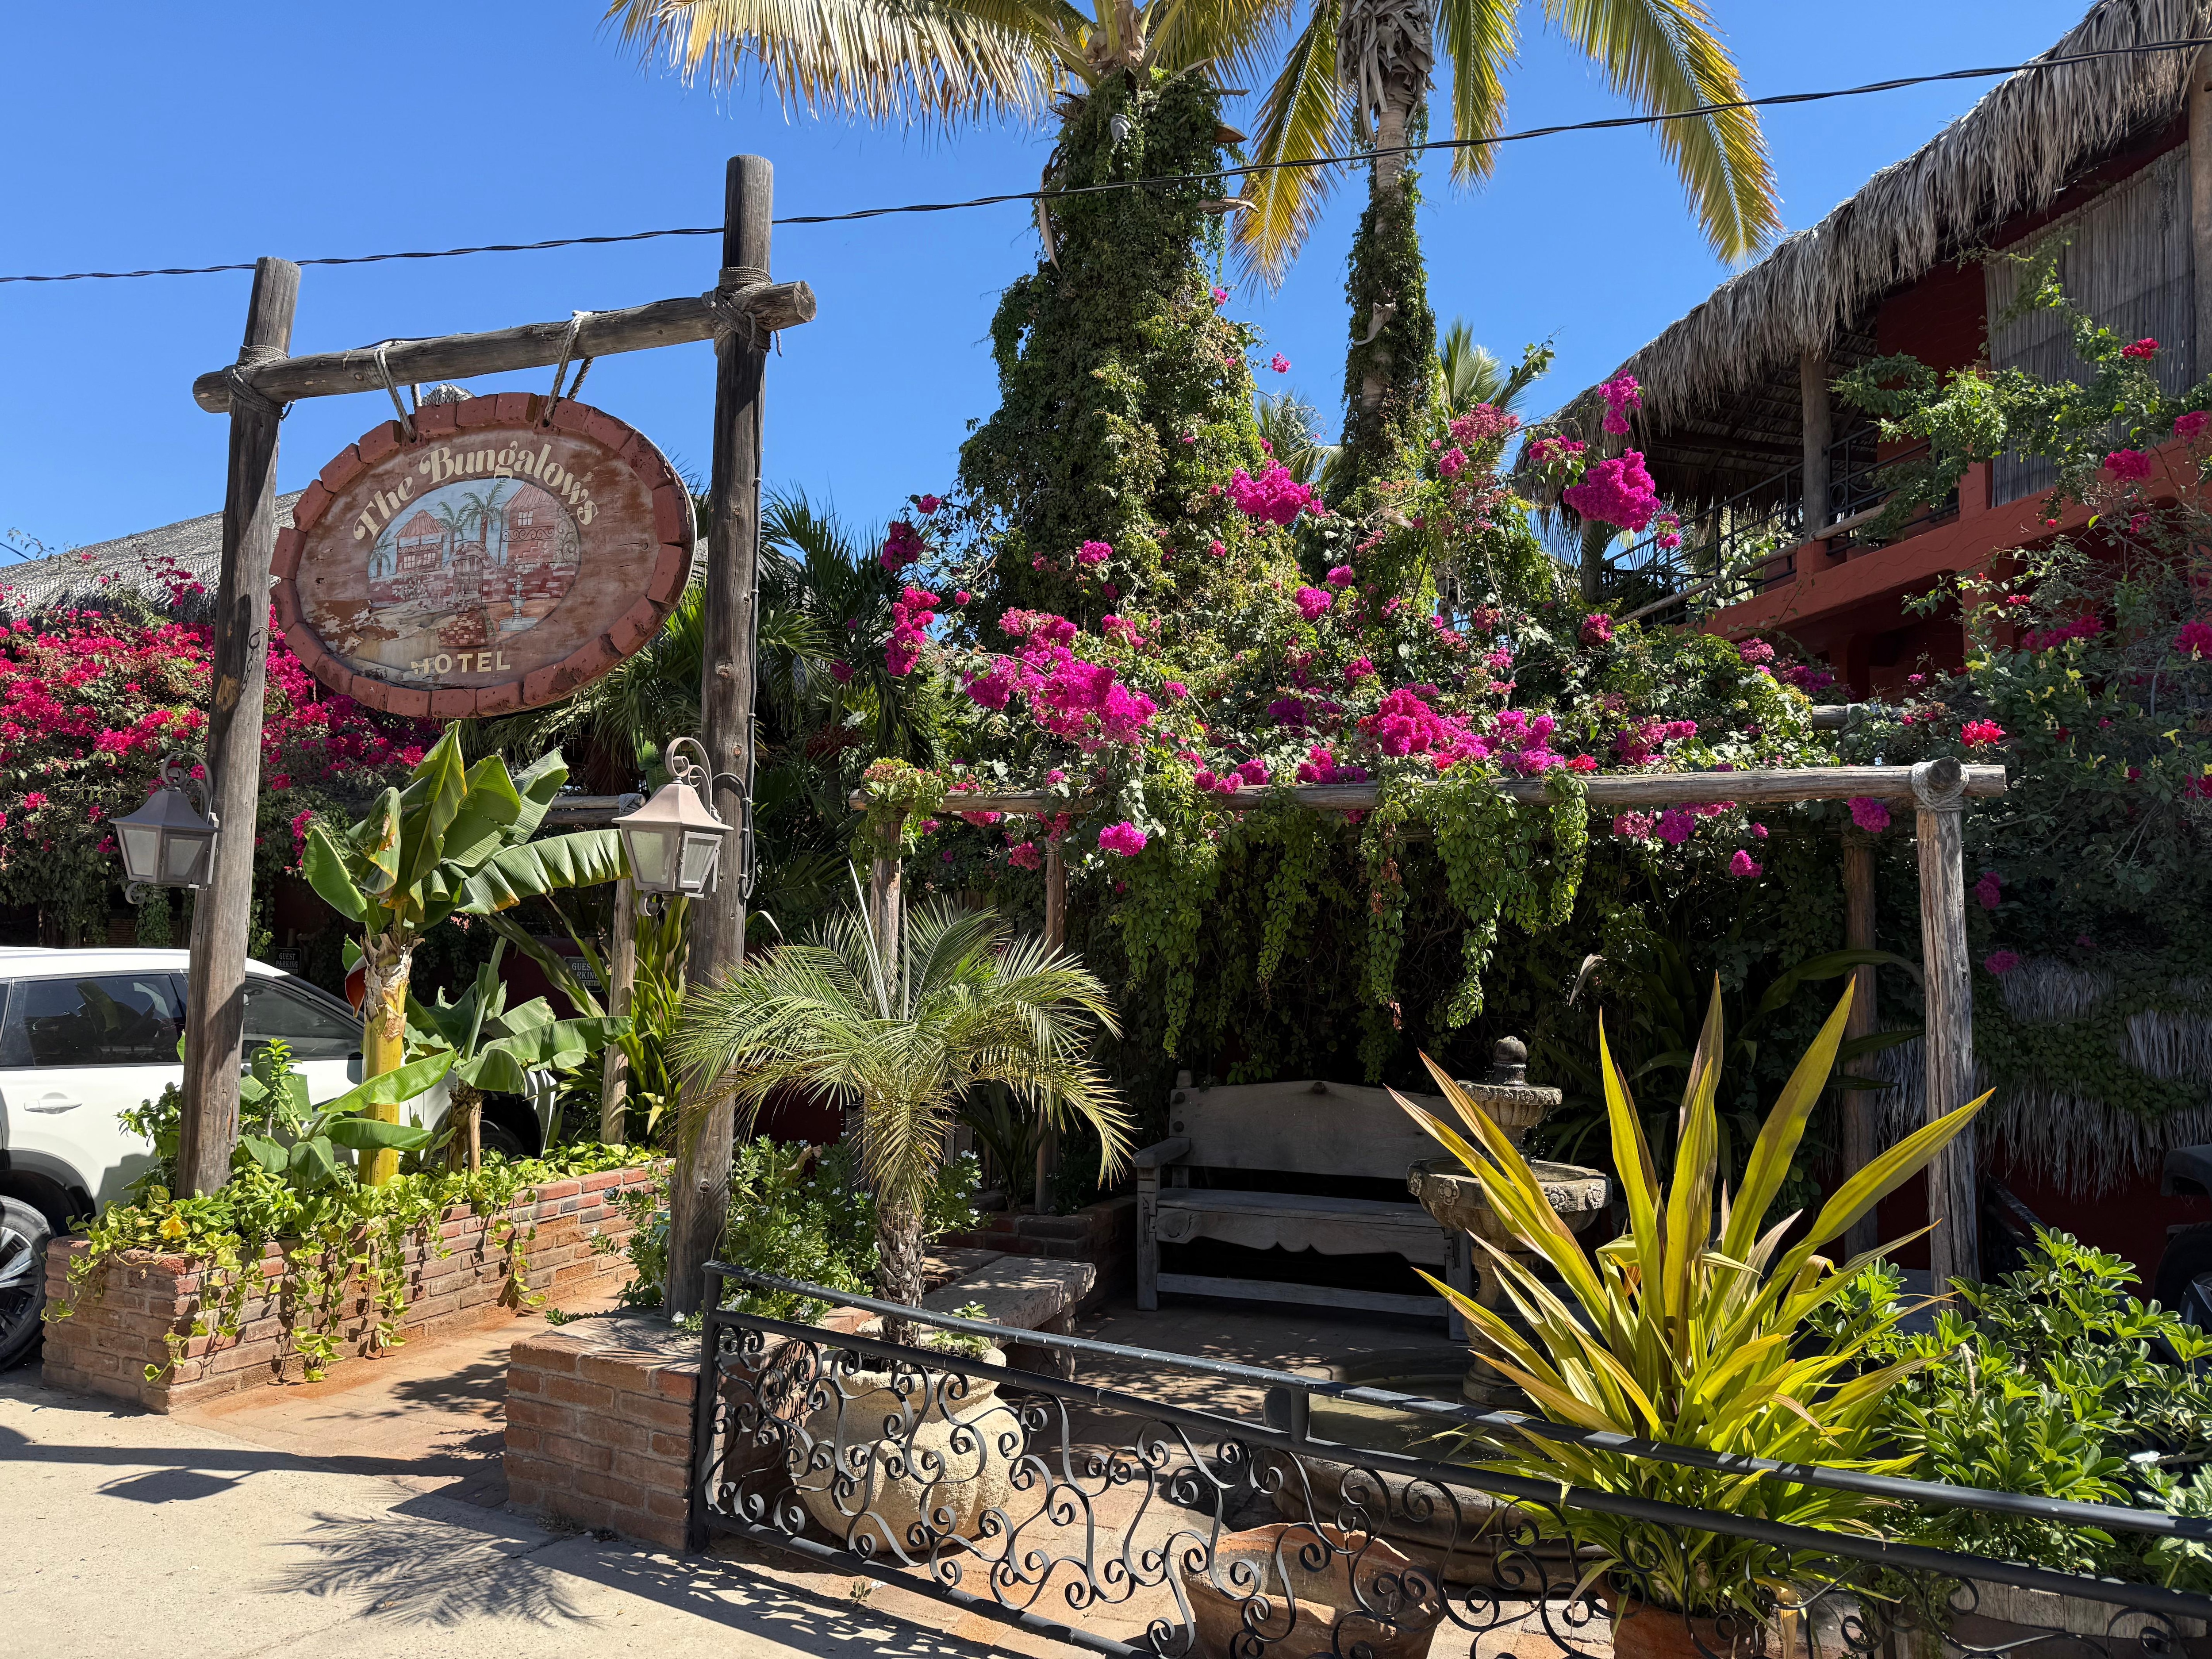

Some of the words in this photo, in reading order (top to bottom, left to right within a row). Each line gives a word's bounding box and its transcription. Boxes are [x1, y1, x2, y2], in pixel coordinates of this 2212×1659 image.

[353, 476, 415, 541] The
[419, 441, 599, 525] Bungalows
[411, 651, 511, 675] HOTEL
[577, 971, 598, 979] RKIN
